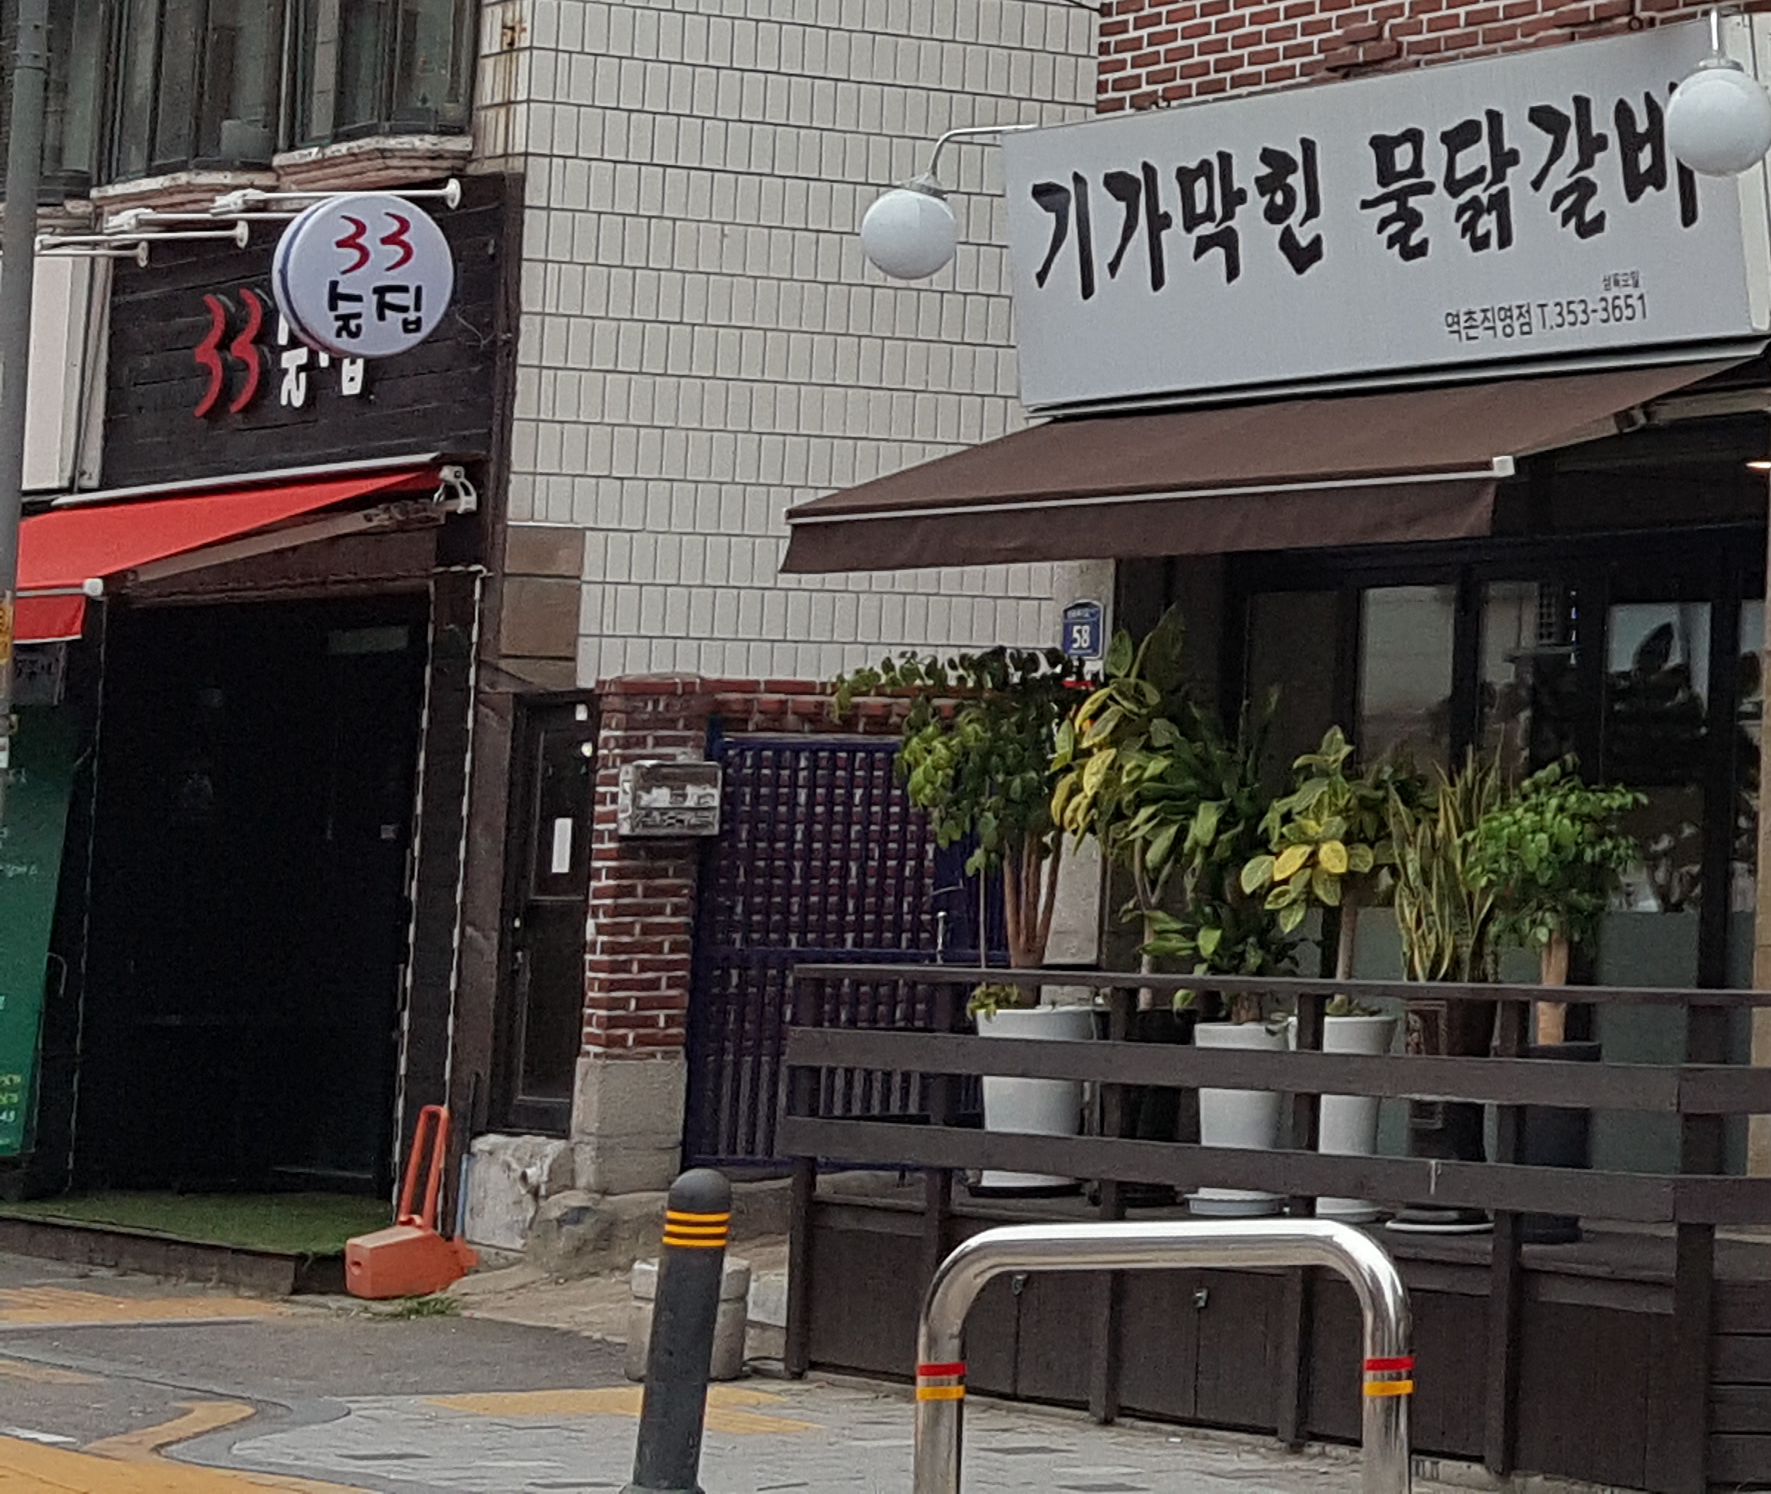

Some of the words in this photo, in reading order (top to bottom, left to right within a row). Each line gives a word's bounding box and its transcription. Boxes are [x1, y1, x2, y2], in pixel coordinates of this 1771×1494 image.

[1031, 136, 1323, 300] 기가막힌
[1360, 81, 1698, 262] 물닭갈비
[334, 212, 415, 275] 33
[1445, 303, 1533, 342] 역촌직영점
[1536, 294, 1647, 330] T.353-3651
[194, 288, 262, 417] 33
[1072, 625, 1090, 648] 58
